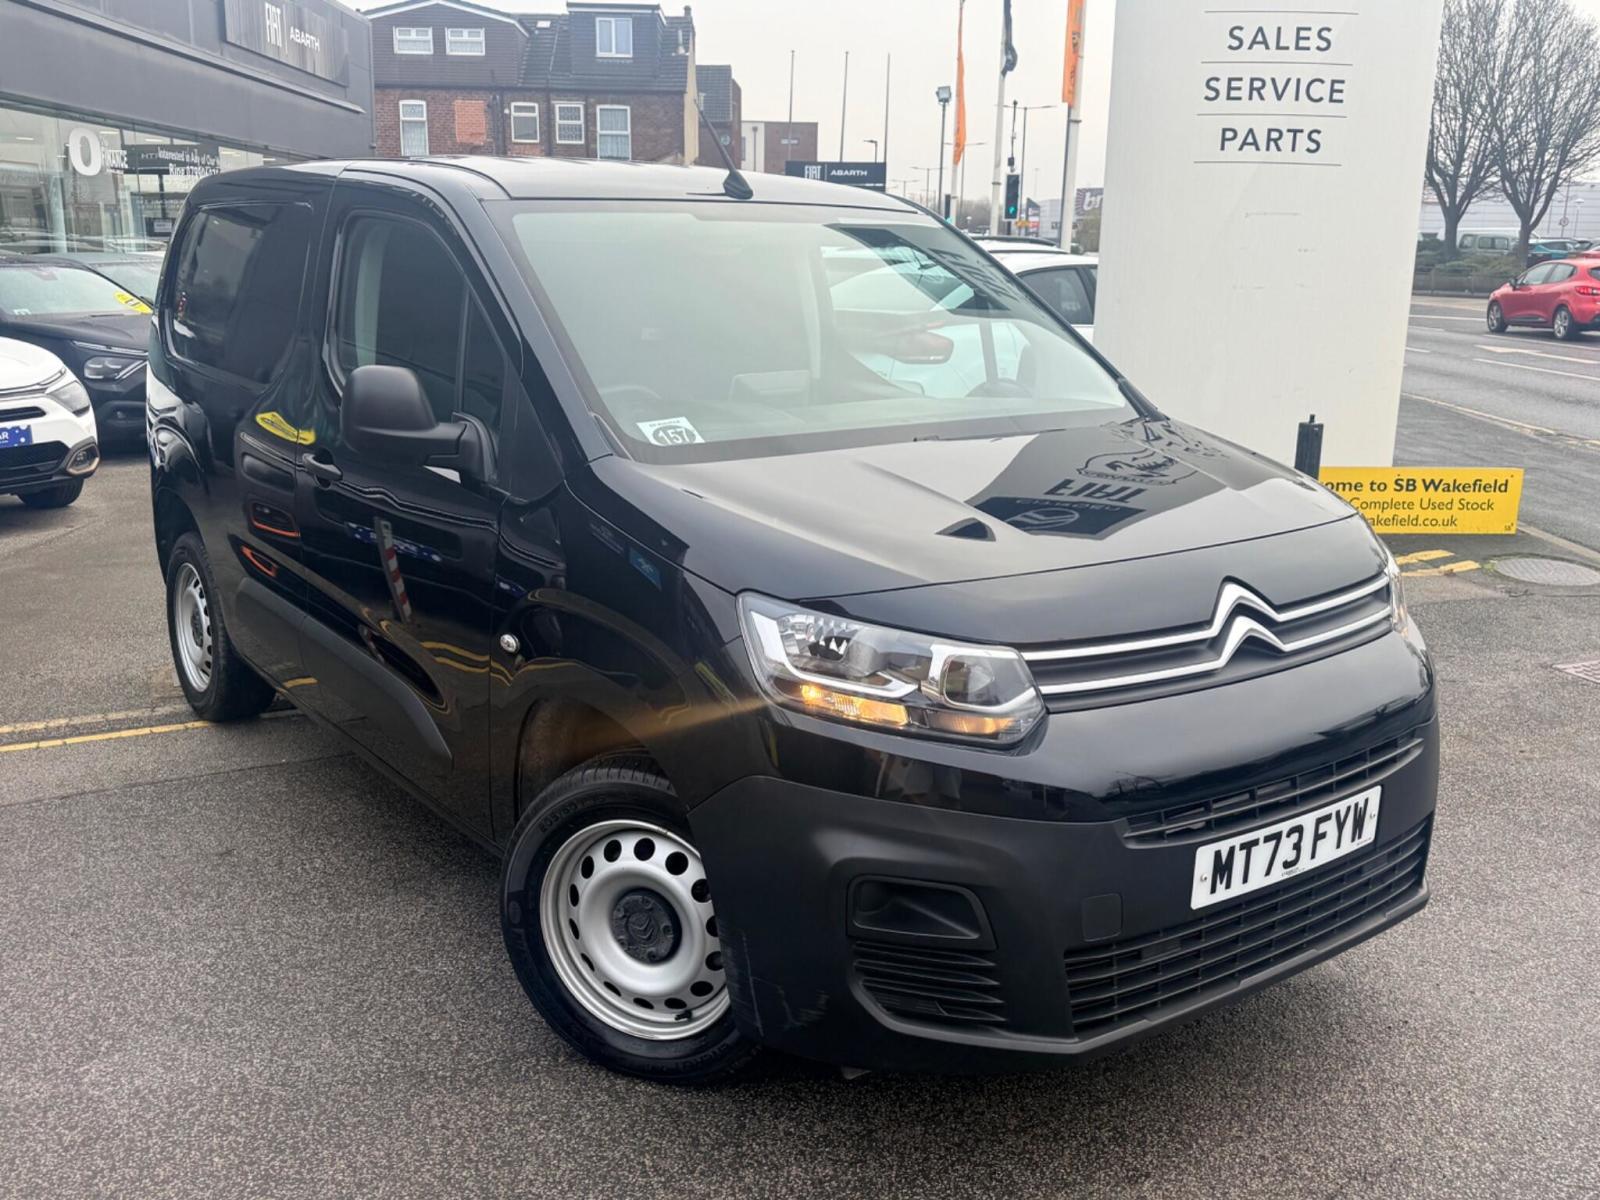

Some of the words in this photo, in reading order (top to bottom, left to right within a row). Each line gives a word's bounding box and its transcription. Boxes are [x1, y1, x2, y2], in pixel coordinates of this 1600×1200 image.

[264, 2, 282, 48] FIAT
[289, 25, 320, 53] ABARTH
[1227, 25, 1332, 52] SALES
[1203, 76, 1346, 104] SERVICE
[1219, 127, 1322, 154] PARTS
[804, 165, 822, 180] FIAT
[830, 169, 868, 177] ABARTH
[658, 427, 690, 445] 157
[1323, 480, 1363, 492] ome
[1369, 480, 1387, 492] to
[1393, 478, 1417, 492] SB
[1422, 478, 1509, 493] Wakefield
[1350, 497, 1415, 513] Complete
[1419, 497, 1454, 511] Used
[1458, 497, 1495, 512] Stock
[1209, 824, 1304, 894] MT73
[1310, 797, 1370, 860] FYW
